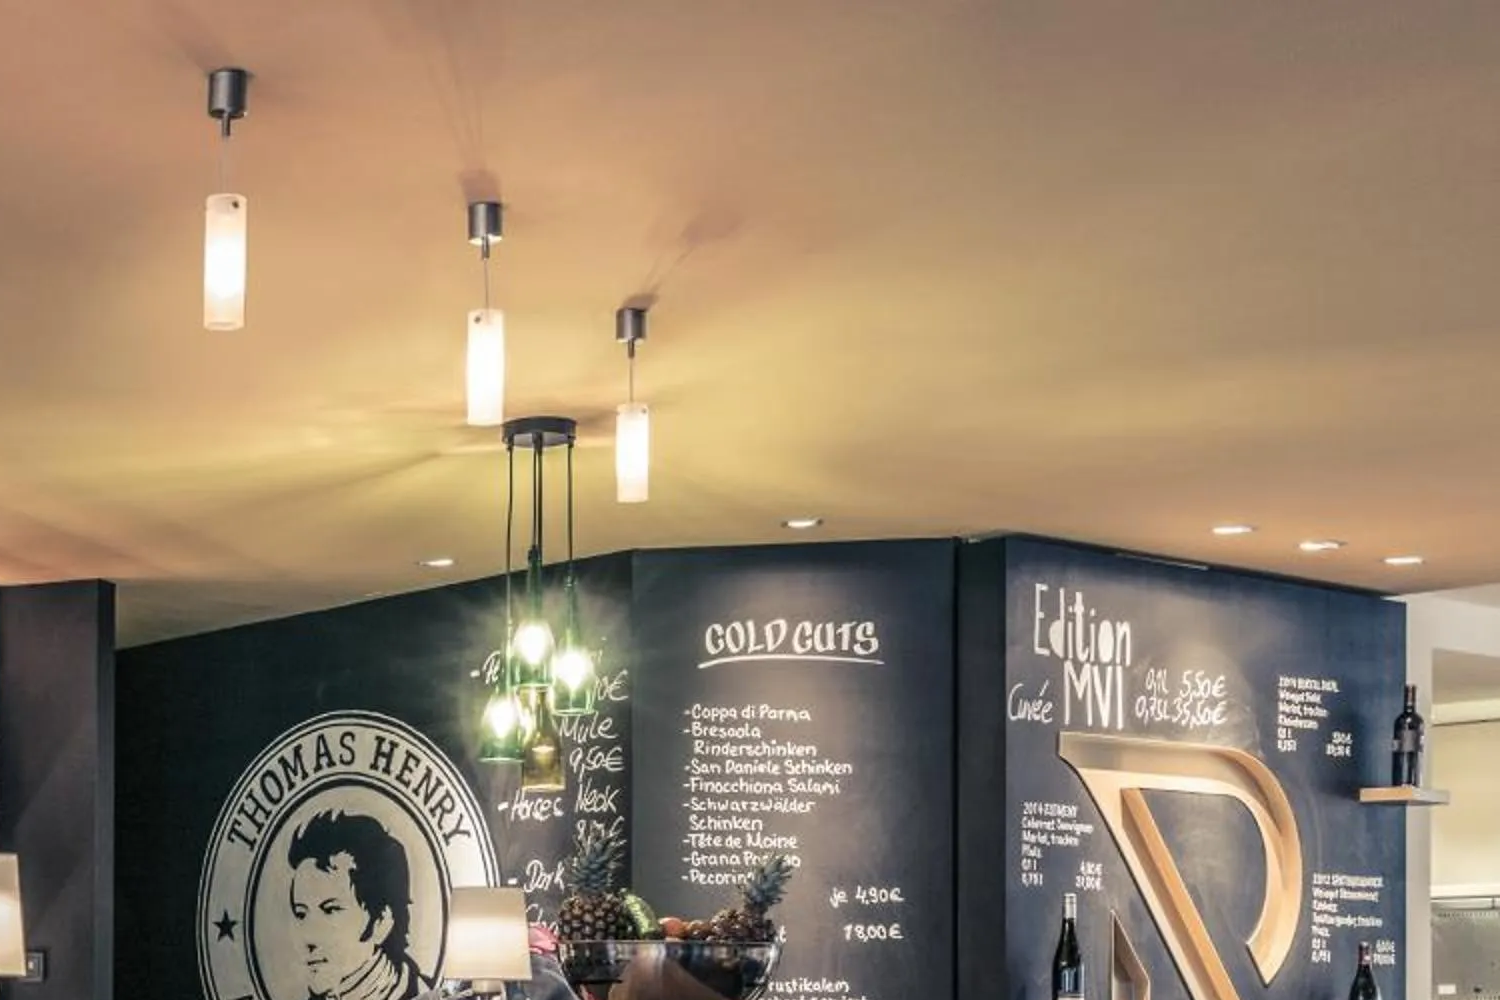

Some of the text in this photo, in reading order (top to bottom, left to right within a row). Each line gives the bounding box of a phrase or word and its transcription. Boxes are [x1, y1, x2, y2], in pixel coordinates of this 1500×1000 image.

[1033, 583, 1131, 667] Edition
[705, 618, 879, 655] COLD CUTS
[1179, 670, 1228, 700] 5,50€
[1007, 660, 1124, 731] Cuvée MVI
[741, 705, 755, 719] di
[559, 711, 620, 743] Mule
[693, 739, 818, 757] Rinderschinken
[725, 760, 781, 775] Daniele
[785, 760, 853, 776] Schinken
[227, 731, 472, 853] THOMAS HENRY
[688, 815, 764, 832] Schinken
[725, 835, 742, 849] de
[746, 832, 798, 849] Moine
[855, 885, 905, 905] 4,90€
[843, 923, 905, 943] 18,00€
[768, 977, 850, 994] rustikalem
